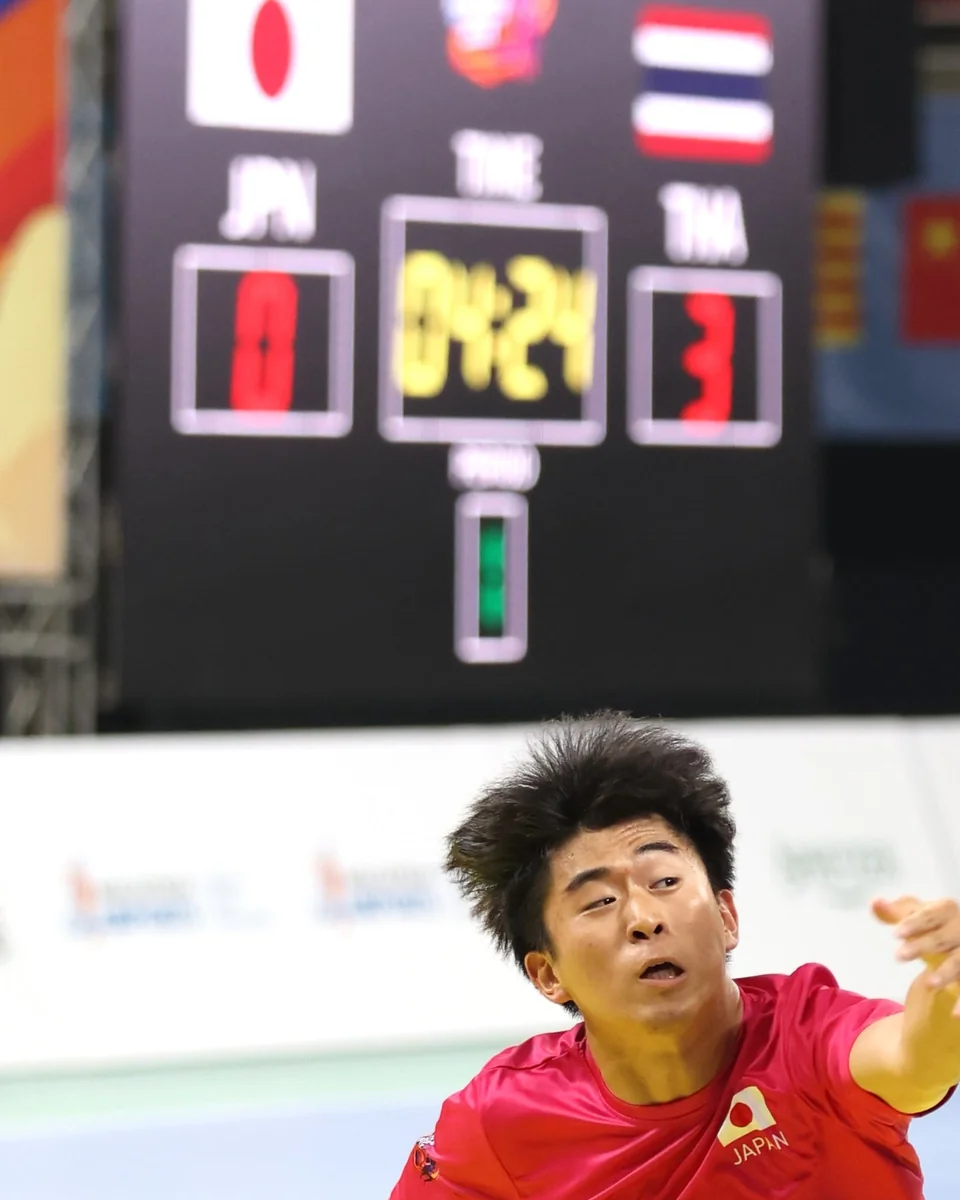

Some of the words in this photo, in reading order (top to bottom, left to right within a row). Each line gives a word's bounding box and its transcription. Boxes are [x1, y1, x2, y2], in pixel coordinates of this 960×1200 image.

[230, 269, 299, 426] 0
[681, 291, 736, 438] 3
[733, 1130, 790, 1166] JAPAN
